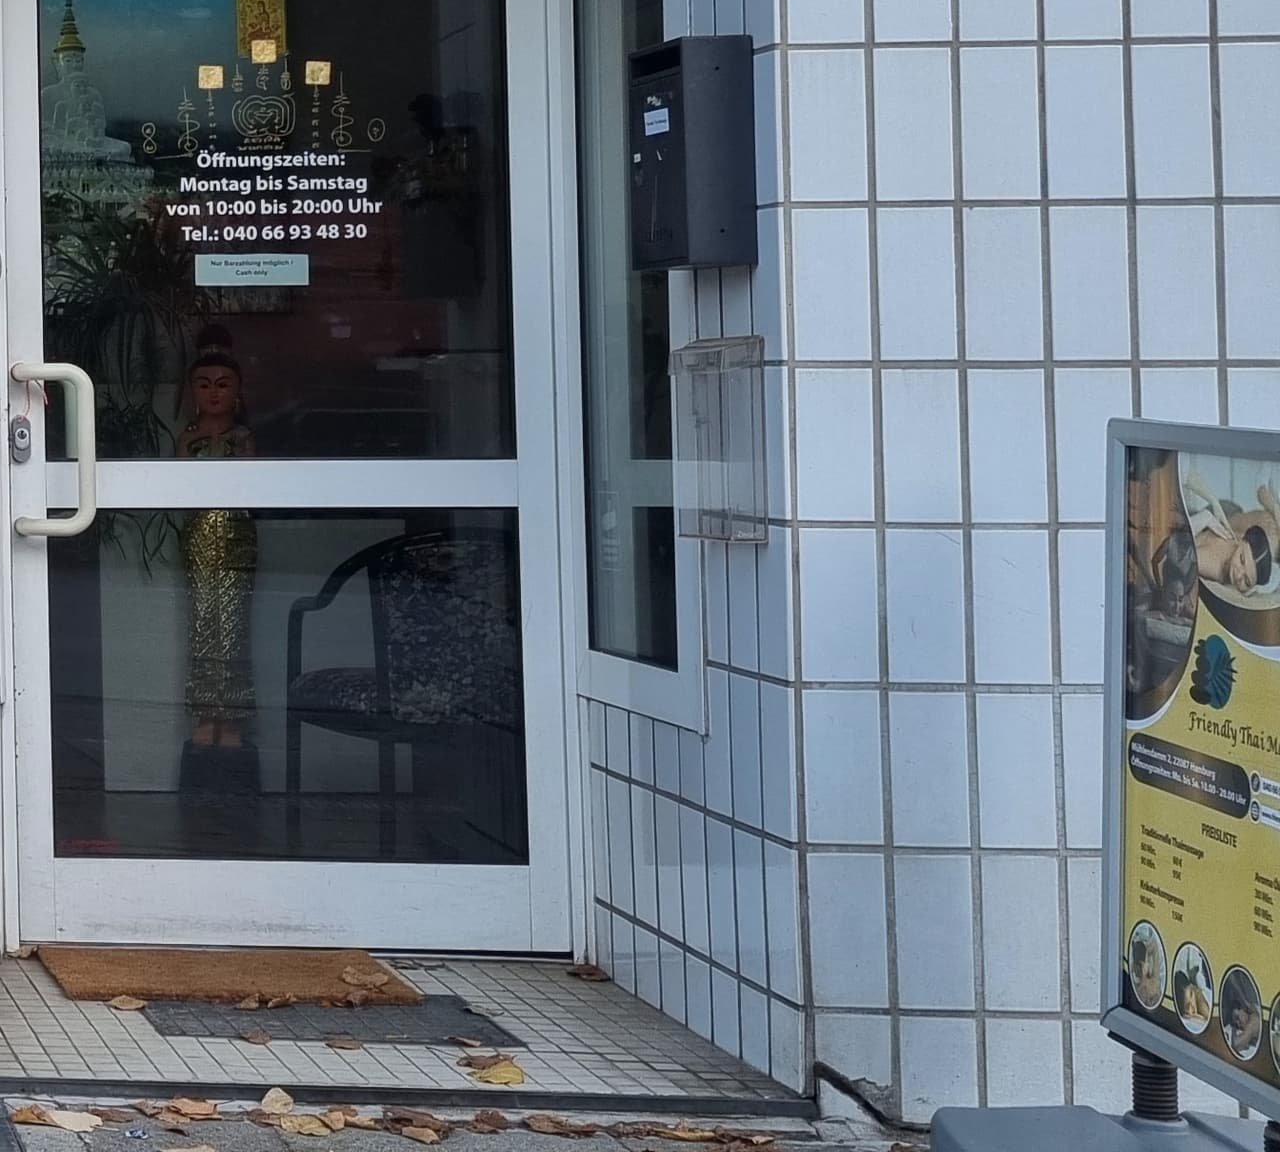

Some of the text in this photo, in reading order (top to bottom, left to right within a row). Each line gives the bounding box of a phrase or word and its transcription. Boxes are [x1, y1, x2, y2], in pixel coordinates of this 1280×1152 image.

[197, 150, 345, 170] Öffnungszeiten:
[181, 176, 367, 195] Montag bis Samstag
[166, 198, 382, 215] von 10:00 bis 20:00 Uhr
[181, 224, 367, 241] Tel.: 040 66 93 48 30
[1188, 711, 1237, 747] Friendly
[1240, 725, 1265, 750] Thai
[1201, 823, 1237, 848] PREISLISTE
